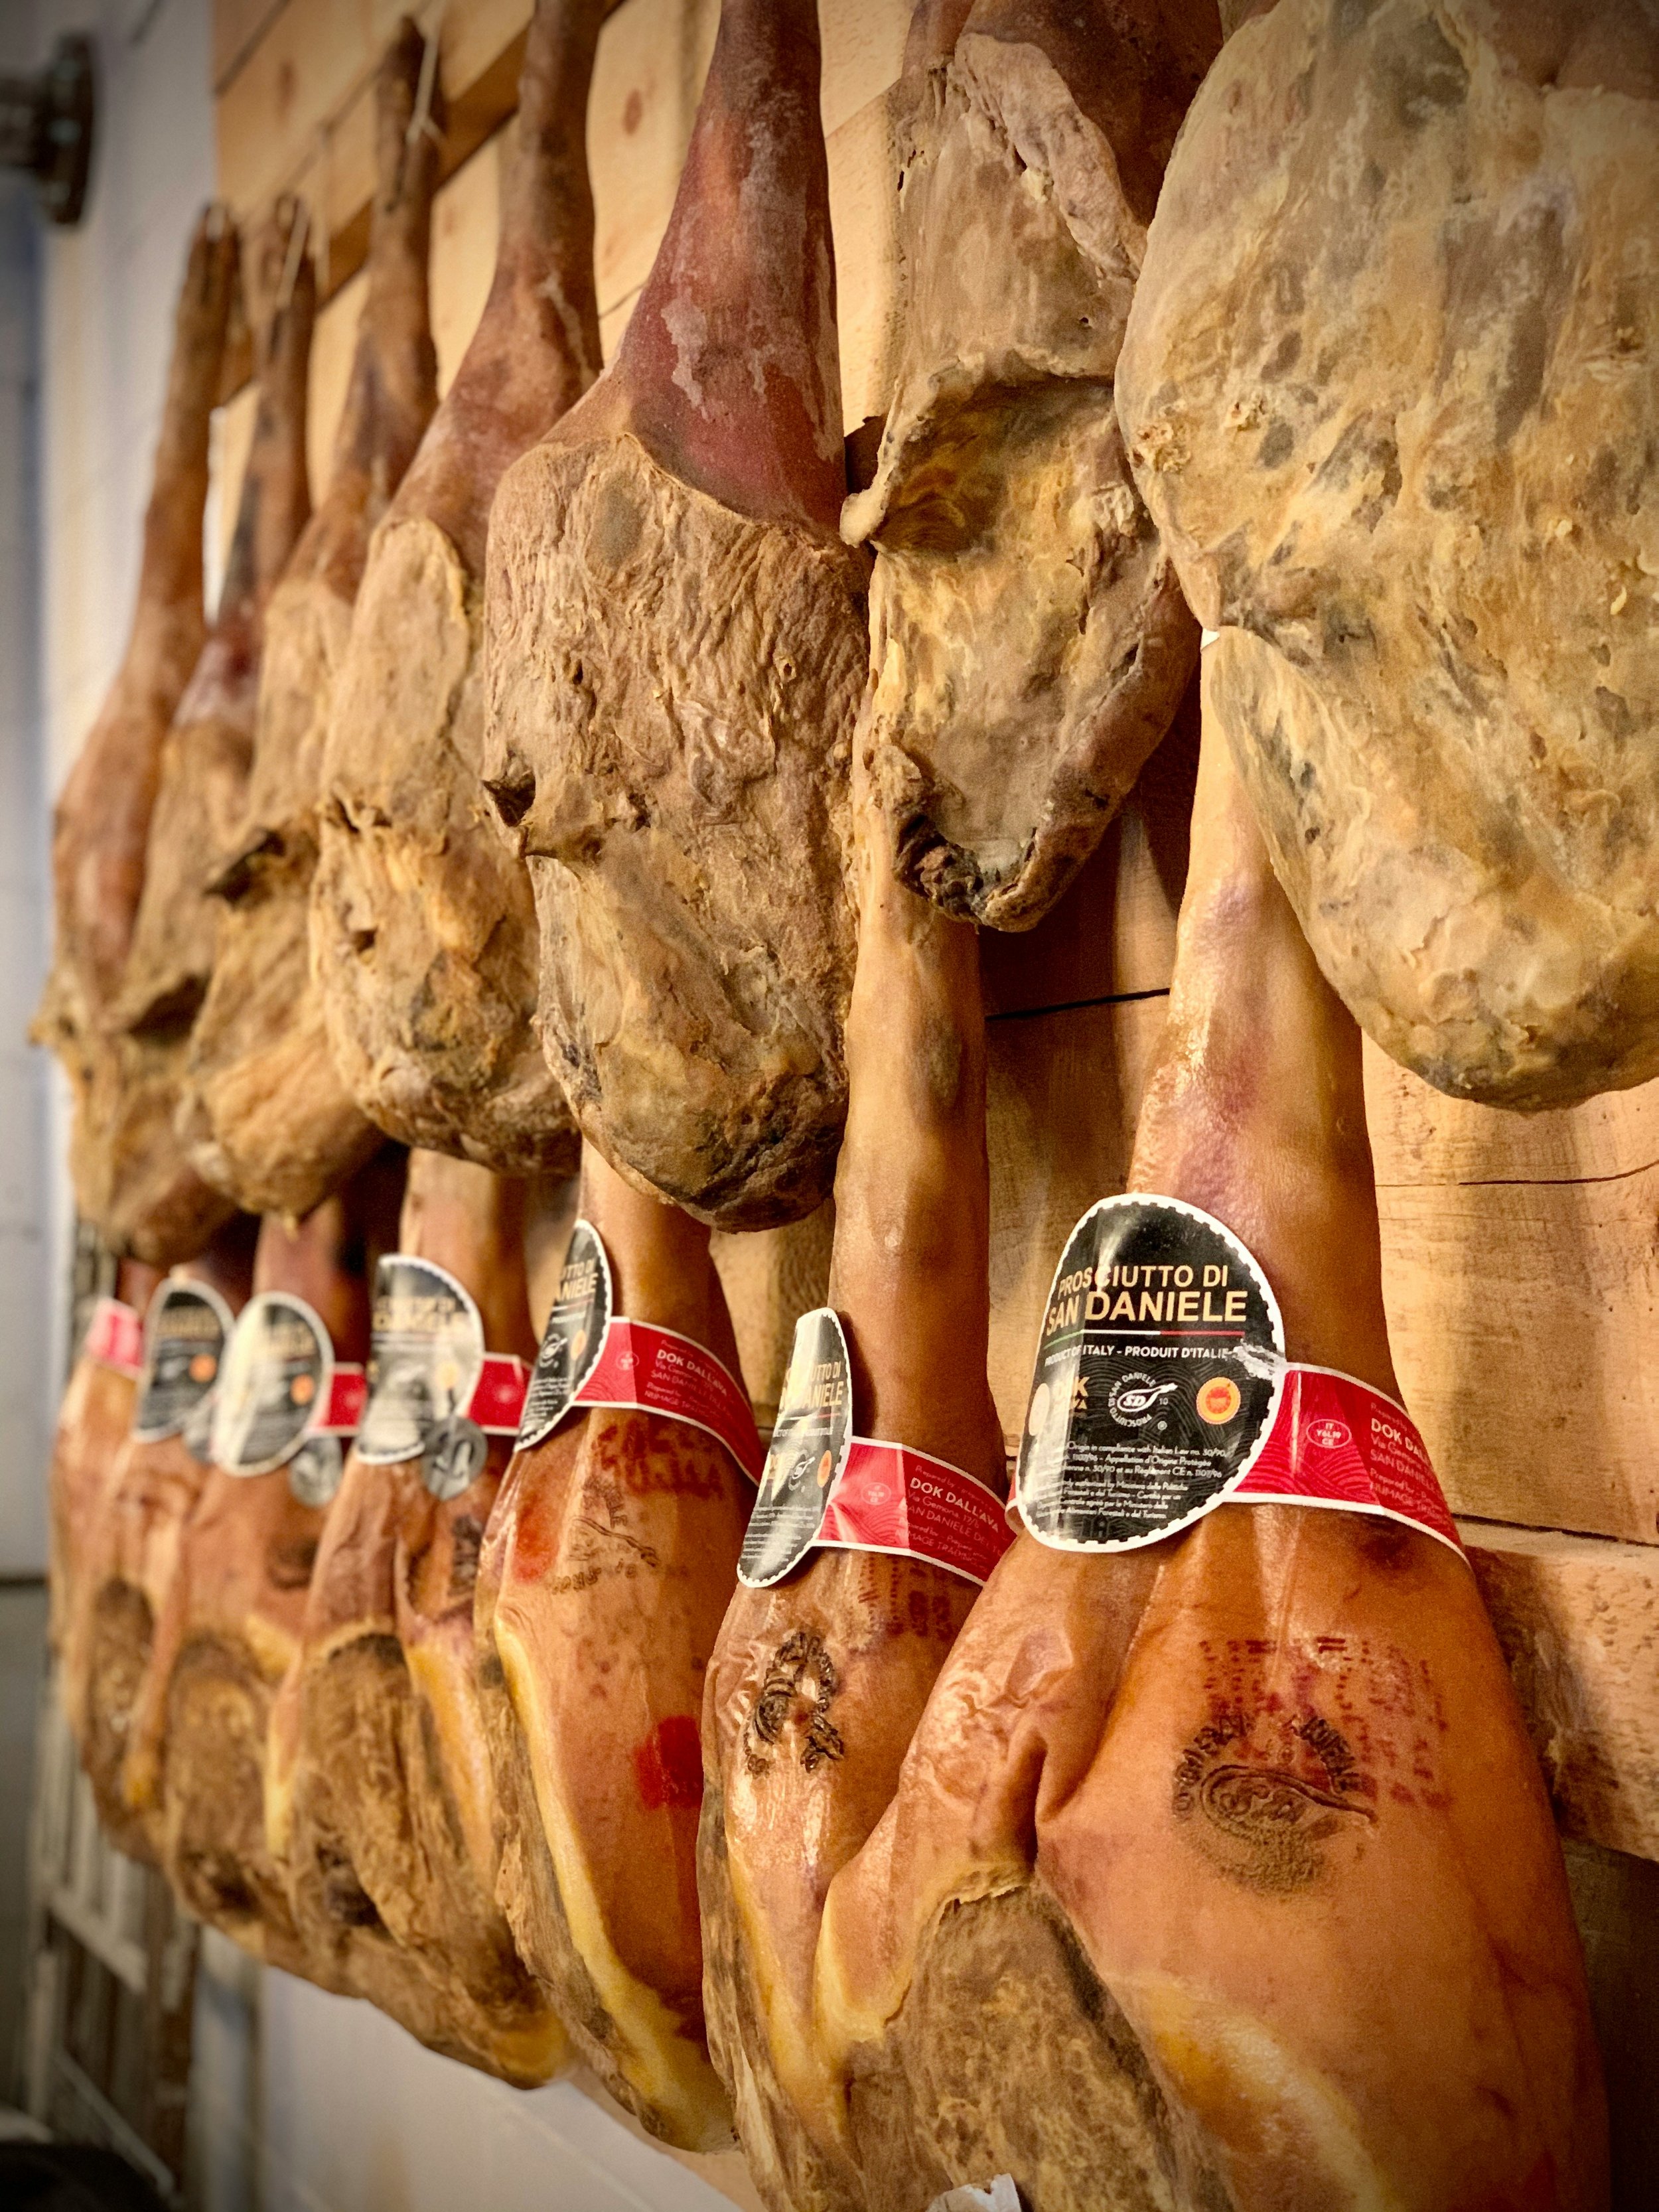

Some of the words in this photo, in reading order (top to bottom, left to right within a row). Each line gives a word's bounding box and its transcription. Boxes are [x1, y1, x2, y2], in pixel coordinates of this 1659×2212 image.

[1058, 1265, 1193, 1300] PROSCIUTTO
[1202, 1264, 1228, 1288] DI
[1046, 1294, 1080, 1336] SAN
[1084, 1290, 1248, 1323] DANIELE
[656, 1349, 685, 1366] DOK
[1082, 1345, 1115, 1357] ITALY
[1124, 1345, 1179, 1359] PRODUIT
[1370, 1418, 1403, 1445] DOK
[1172, 1466, 1186, 1476] CE
[910, 1477, 944, 1499] DOK
[945, 1491, 999, 1534] DALL'AVA
[926, 1511, 973, 1538] DANIELE
